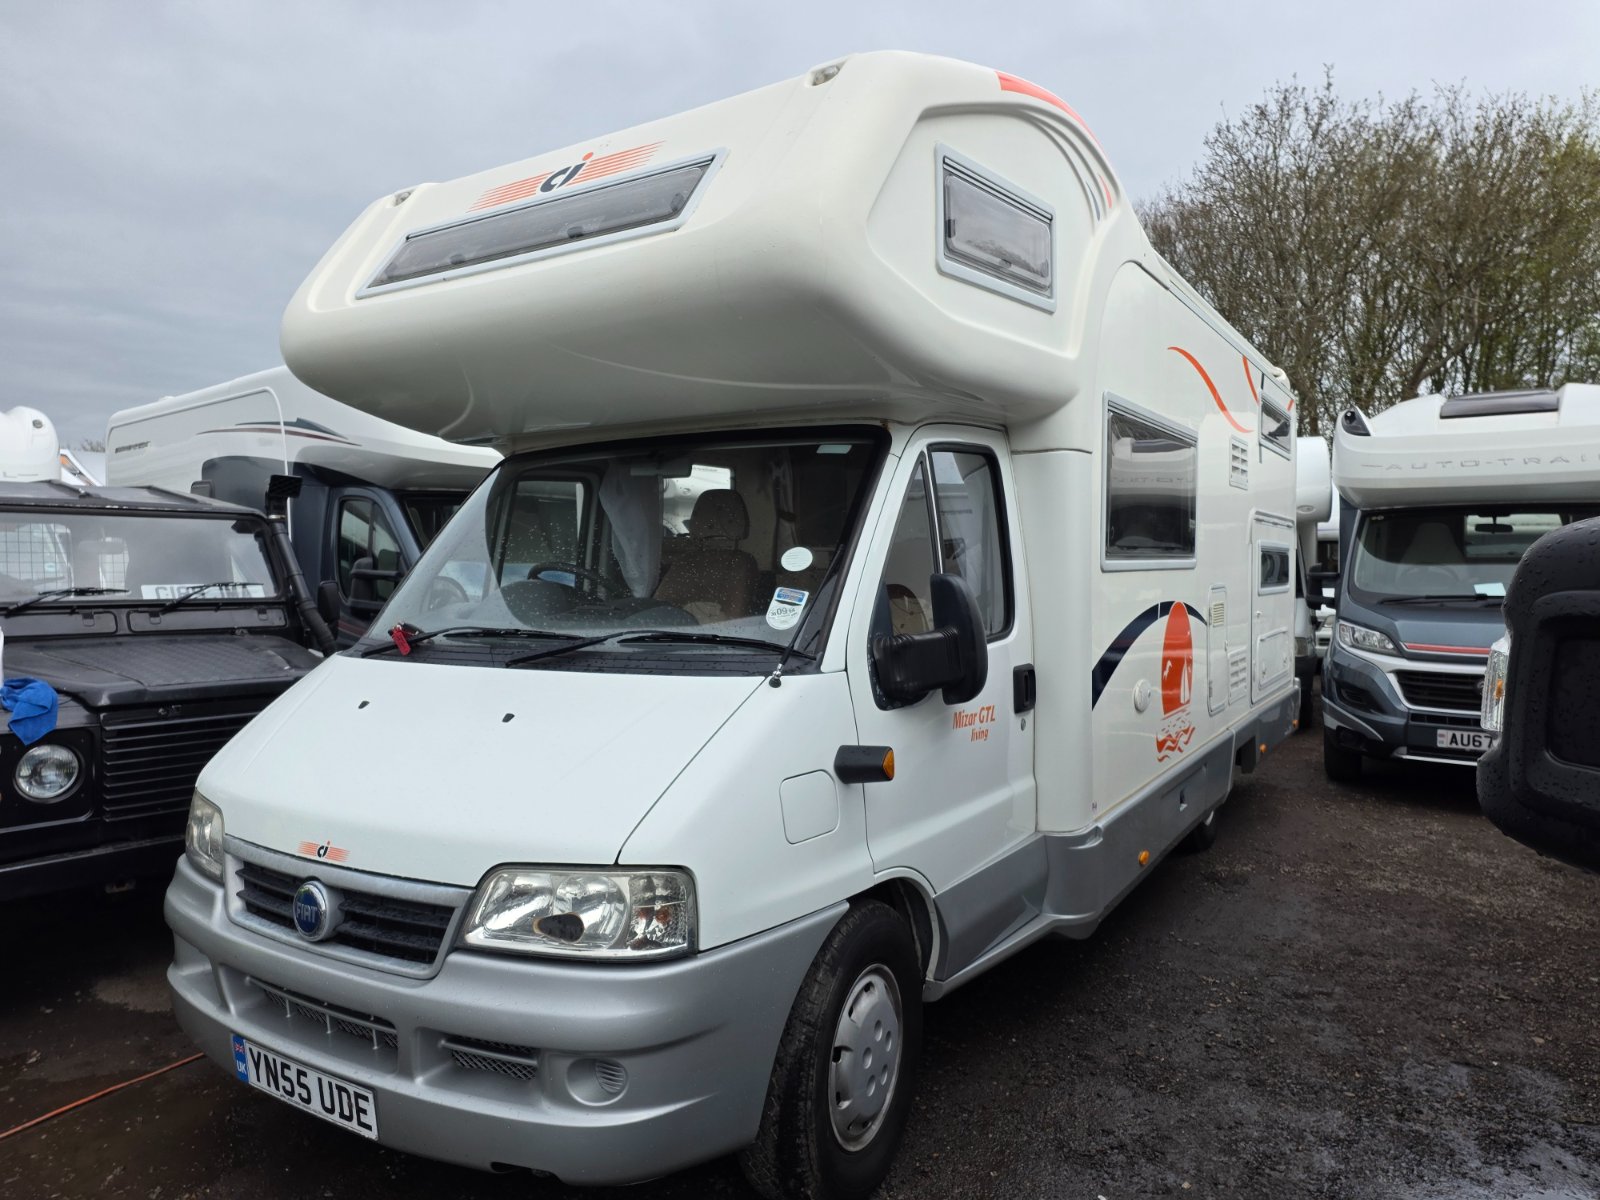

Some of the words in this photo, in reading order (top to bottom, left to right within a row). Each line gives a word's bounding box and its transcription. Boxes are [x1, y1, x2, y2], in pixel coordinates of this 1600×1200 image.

[1385, 453, 1600, 470] AUTO-TRAI
[953, 709, 977, 730] Mizar
[978, 705, 996, 723] GTL
[971, 727, 989, 742] living
[1449, 733, 1493, 748] AU67
[296, 902, 318, 922] FIAT
[236, 1060, 248, 1075] UK
[249, 1047, 312, 1105] YN55
[317, 1077, 373, 1132] UDE
